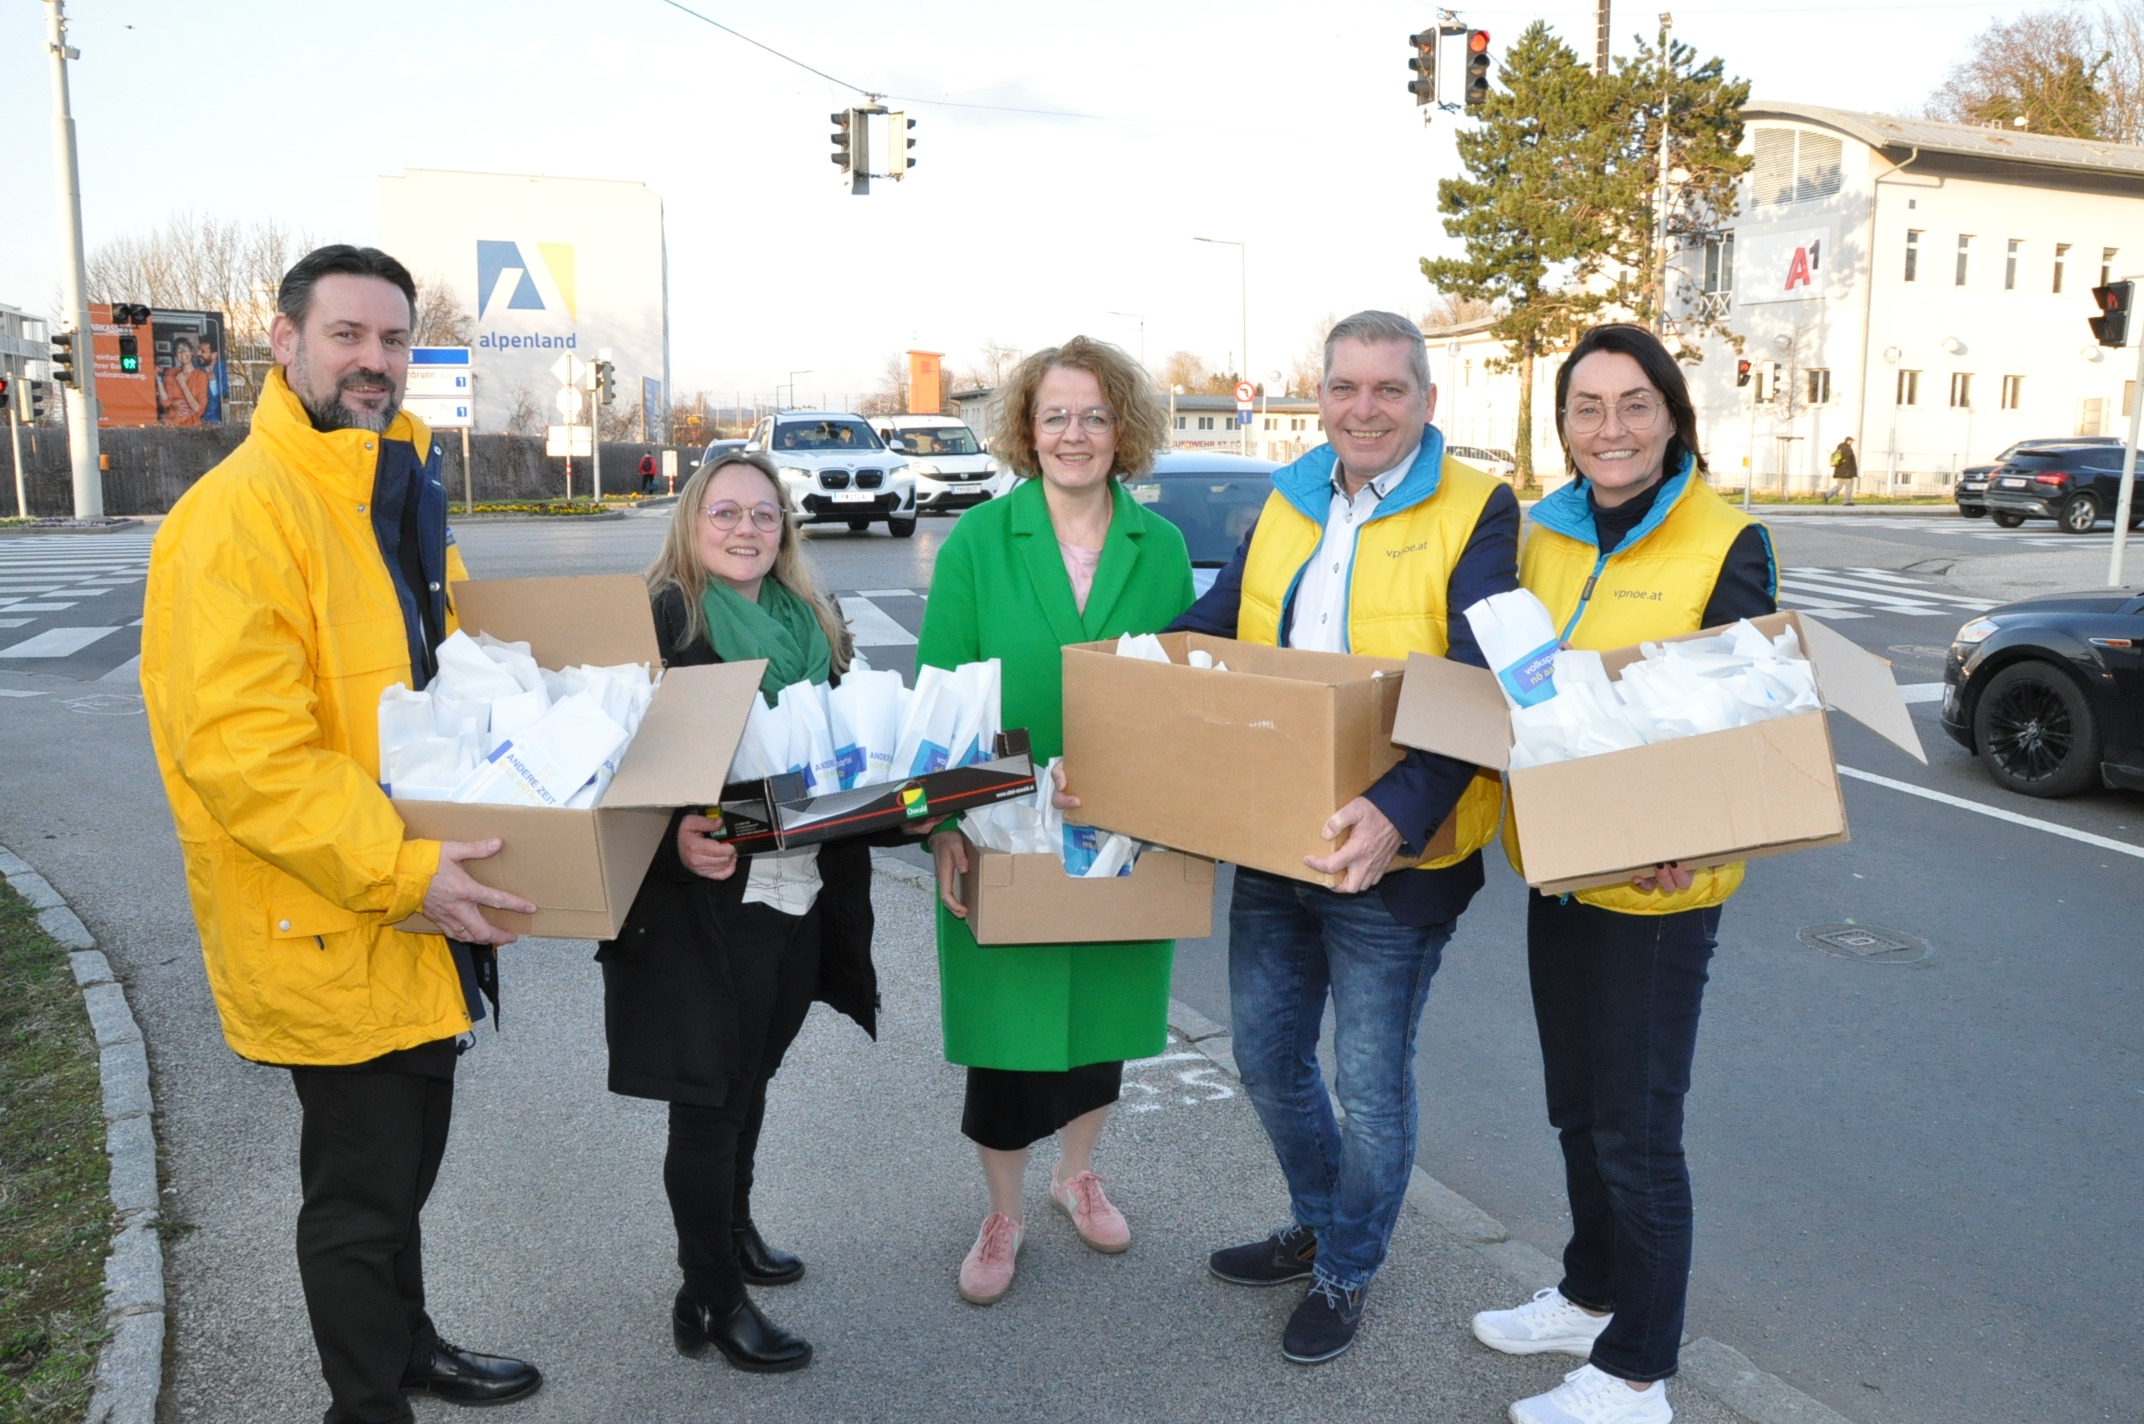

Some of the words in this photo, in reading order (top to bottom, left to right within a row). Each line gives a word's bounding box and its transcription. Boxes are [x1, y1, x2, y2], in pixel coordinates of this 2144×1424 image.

[1785, 239, 1820, 291] A1
[479, 331, 577, 352] alpenland
[1613, 589, 1663, 602] vpnoe.at
[506, 753, 539, 789] ANDERE
[536, 784, 557, 806] ZEIT
[906, 804, 929, 816] Oswald
